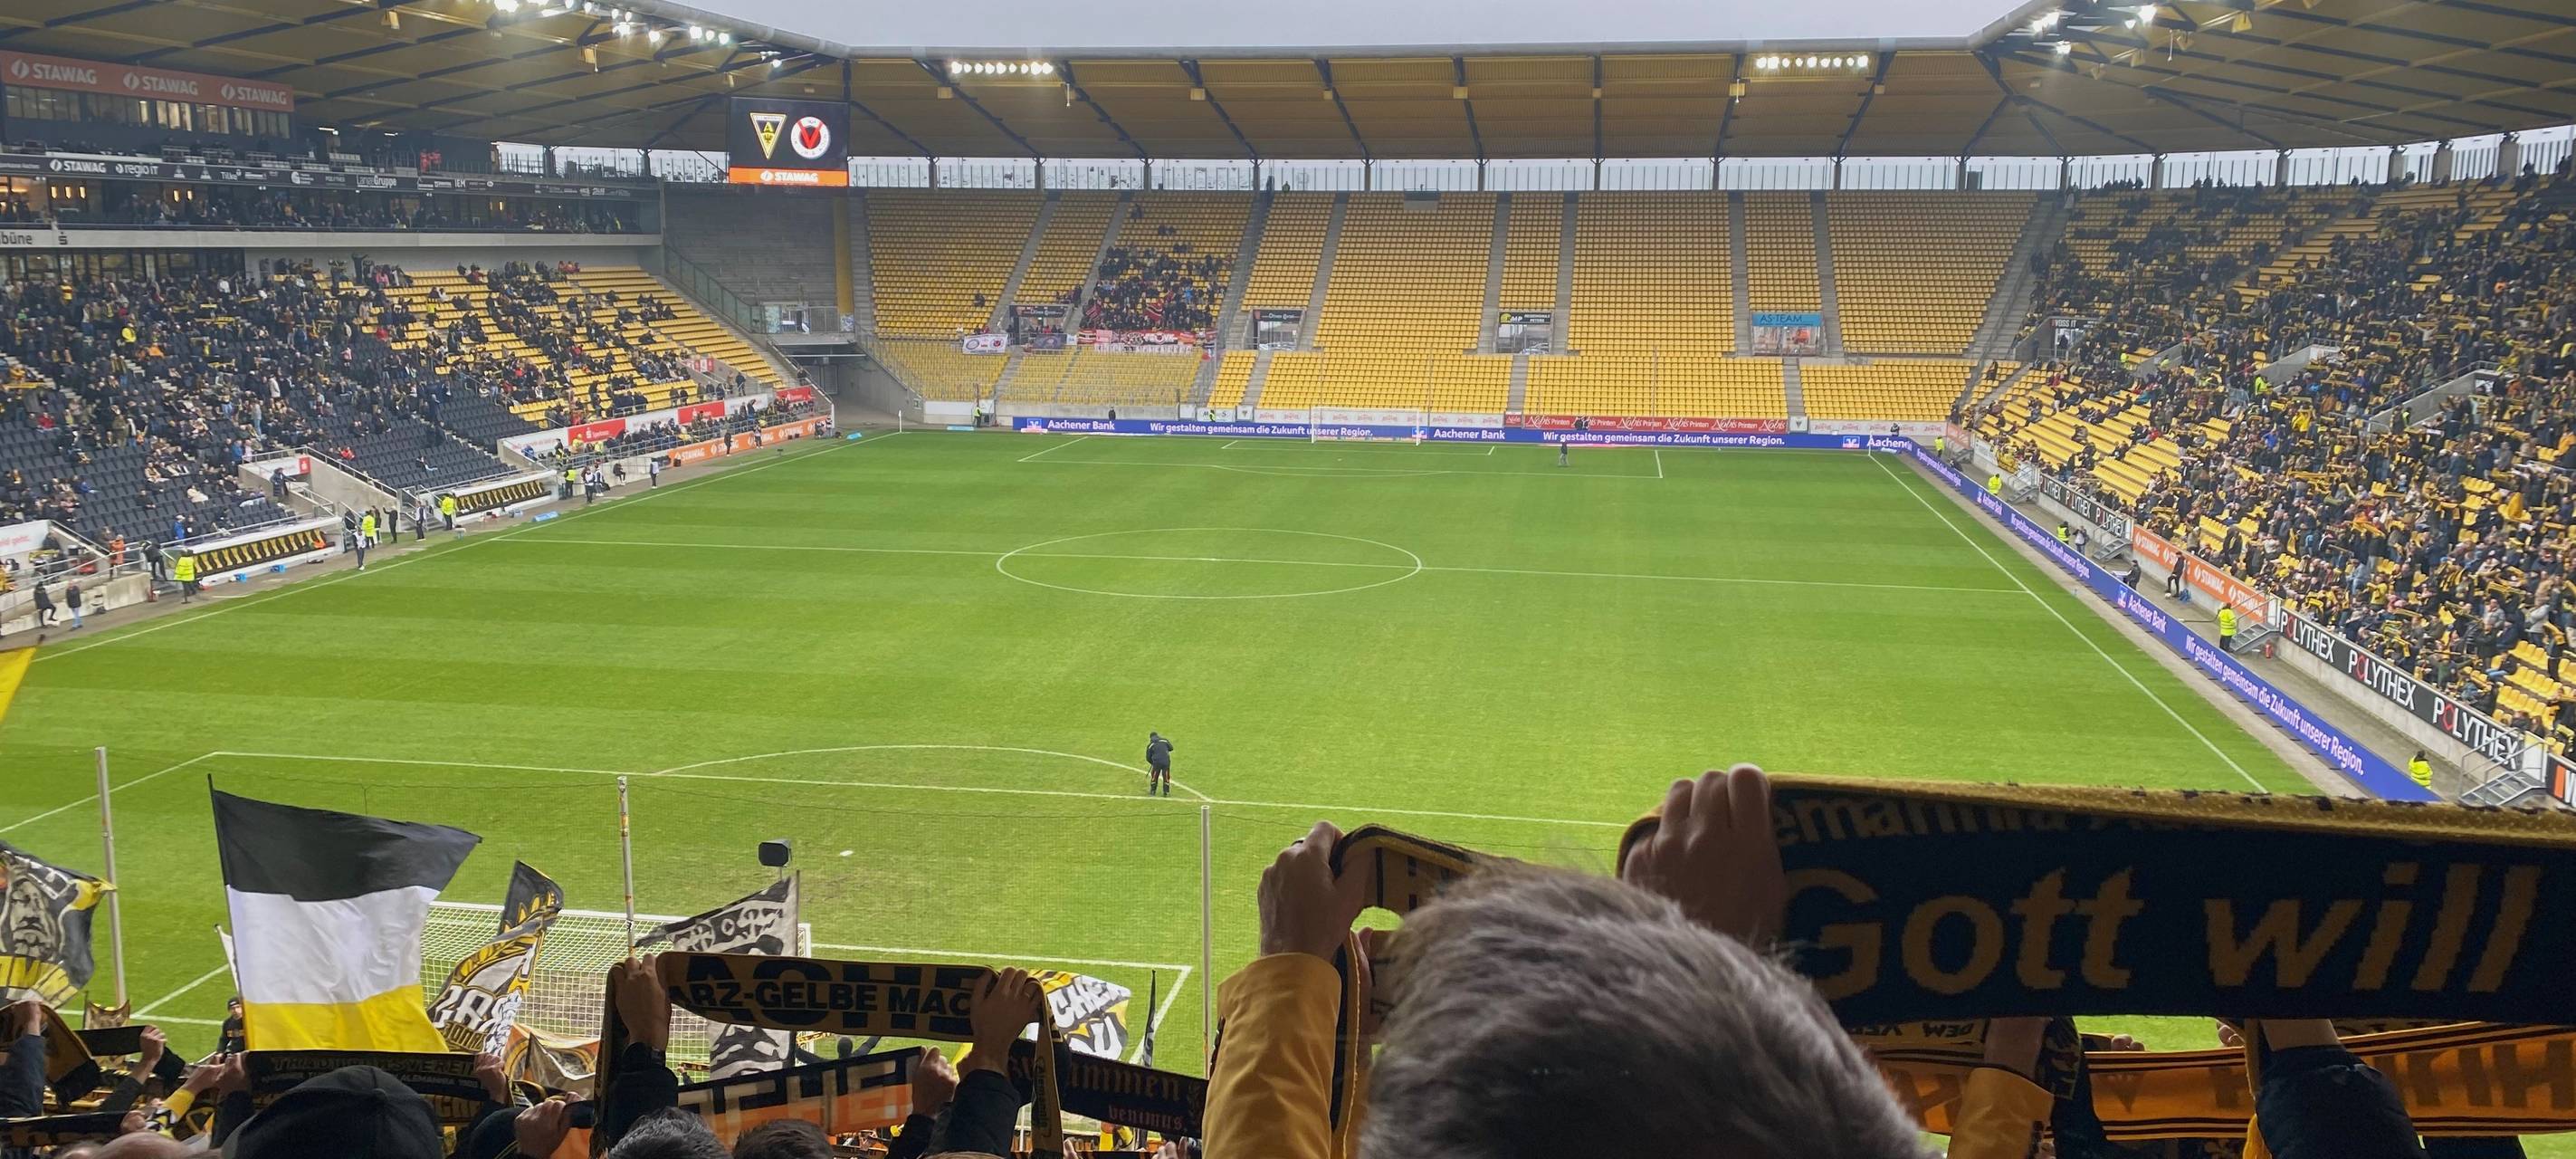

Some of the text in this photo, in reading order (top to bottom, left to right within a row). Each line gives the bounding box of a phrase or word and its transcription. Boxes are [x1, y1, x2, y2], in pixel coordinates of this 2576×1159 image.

[33, 62, 97, 84] STAWAG
[142, 76, 198, 96] STAWAG
[238, 87, 287, 106] STAWAG
[63, 161, 107, 174] STAWAG
[774, 171, 819, 182] STAWAG
[1048, 420, 1115, 430] Aachener Bank
[1150, 423, 1373, 438] Wir gestalten gemeinsam die Zukunft unserer Region.
[1434, 428, 1505, 440] Aachener Bank
[1543, 432, 1785, 446] Wir gestalten gemeinsam die Zukunft unserer Region.
[2201, 570, 2225, 594] STAWAG
[2128, 594, 2168, 634] Aachener Bank
[2280, 609, 2334, 665] POLYTHEX
[2348, 648, 2417, 713] POLYTHEX
[2186, 634, 2364, 776] Wir gestalten gemeinsam die Zukunft unserer Region.
[2432, 696, 2518, 770] POLYTHEX
[1785, 860, 2543, 1003] Gott will
